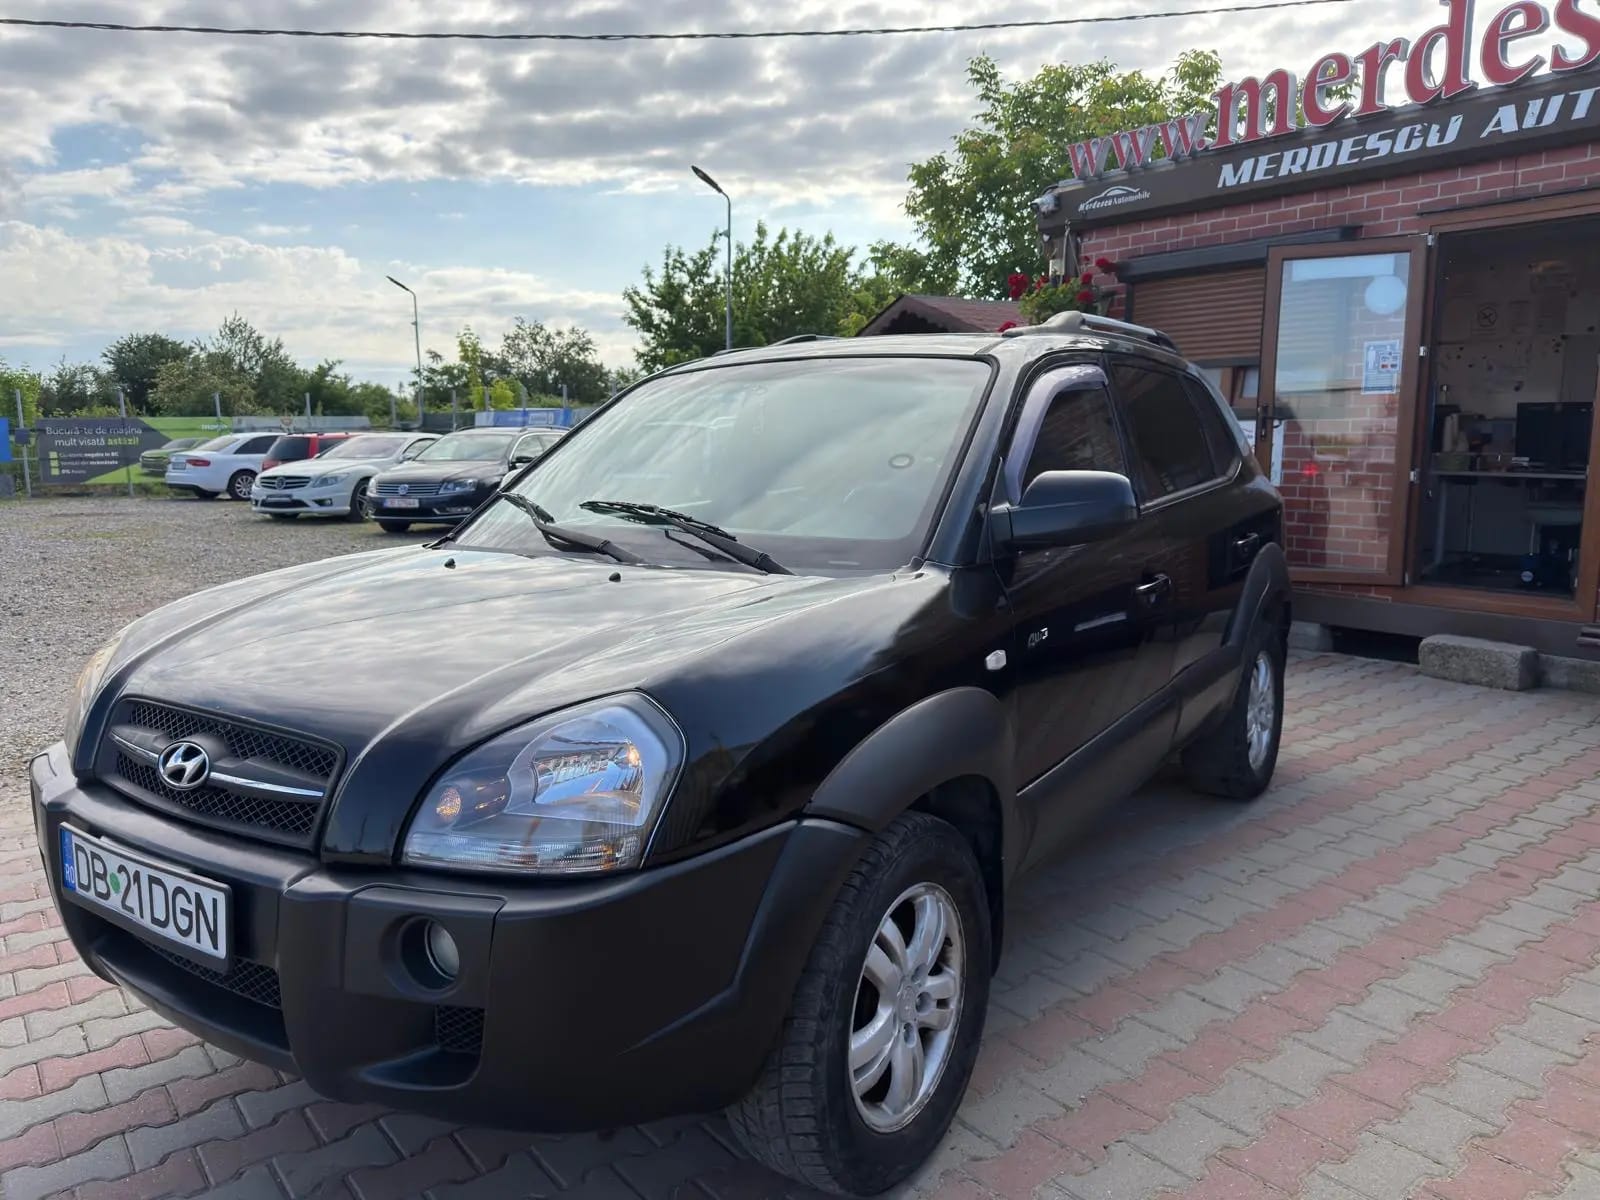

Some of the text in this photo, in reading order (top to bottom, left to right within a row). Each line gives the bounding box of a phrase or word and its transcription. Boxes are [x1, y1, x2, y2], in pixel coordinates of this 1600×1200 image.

[1217, 114, 1464, 188] MERDESCU
[95, 426, 107, 435] de
[55, 438, 78, 446] mult
[65, 864, 75, 884] RO
[75, 843, 111, 901] DB
